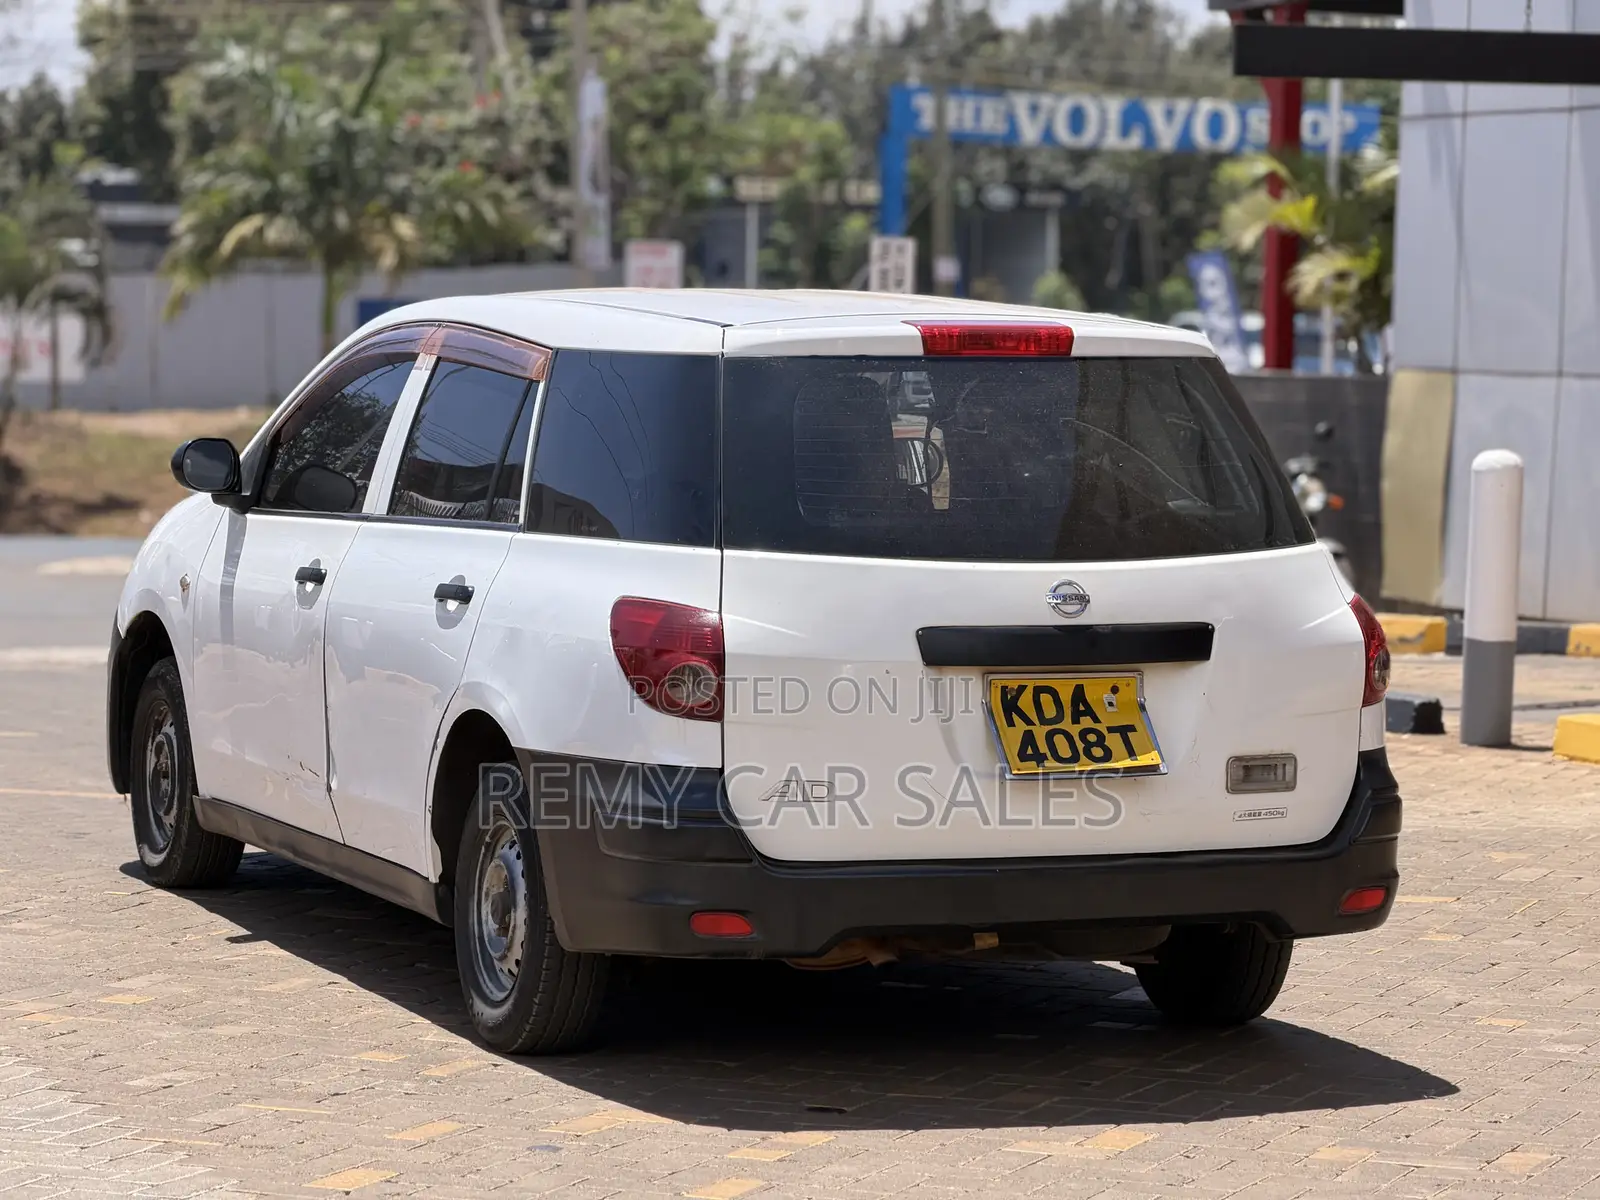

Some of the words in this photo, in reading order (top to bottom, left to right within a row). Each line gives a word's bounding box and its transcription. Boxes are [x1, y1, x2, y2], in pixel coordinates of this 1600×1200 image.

[910, 91, 1010, 135] THE
[1006, 90, 1242, 152] VOLVO
[1051, 594, 1087, 603] NISSAN
[1000, 684, 1102, 728] KDA
[1017, 724, 1138, 768] 408T
[758, 780, 836, 802] AD
